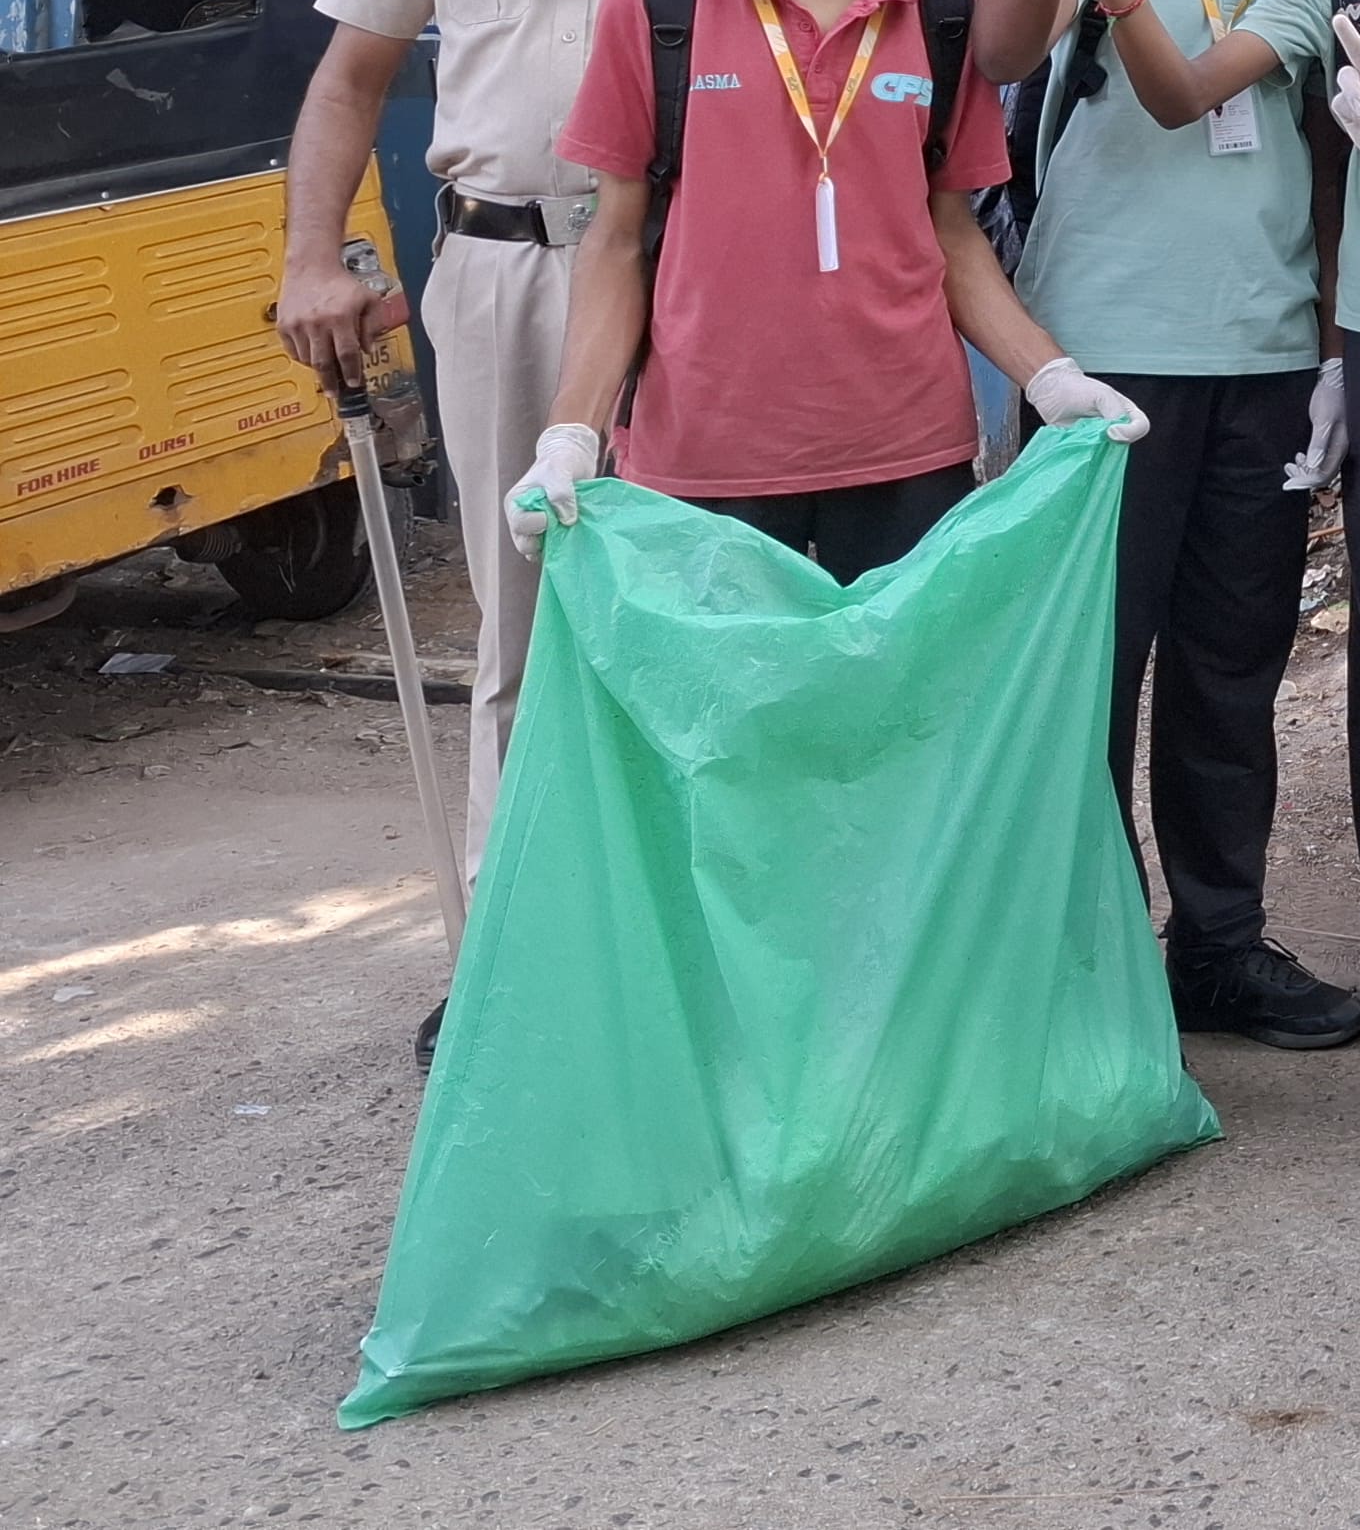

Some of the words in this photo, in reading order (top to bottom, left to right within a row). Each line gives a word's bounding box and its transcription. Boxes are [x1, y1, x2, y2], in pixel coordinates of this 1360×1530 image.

[870, 72, 934, 107] CPS
[17, 474, 54, 497] FOR
[57, 458, 101, 483] HIRE
